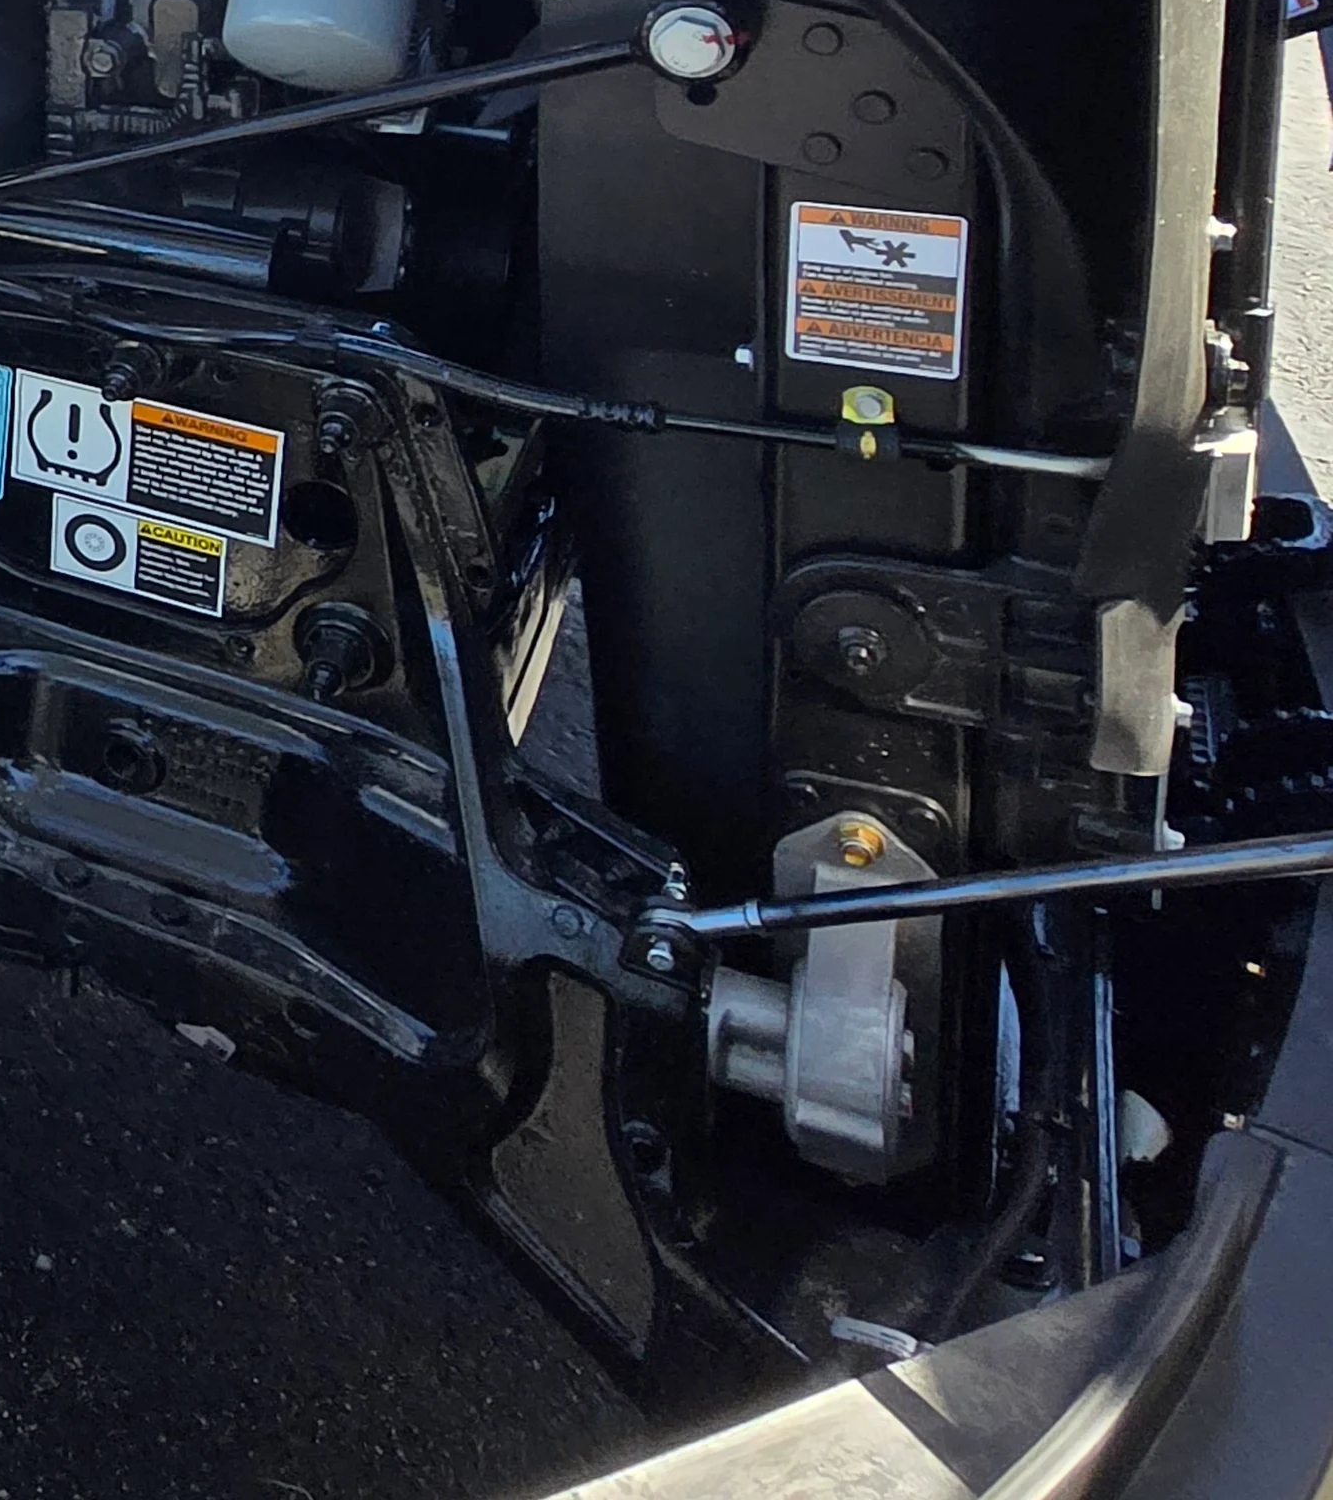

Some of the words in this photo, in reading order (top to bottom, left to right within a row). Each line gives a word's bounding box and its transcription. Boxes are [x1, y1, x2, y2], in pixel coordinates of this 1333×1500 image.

[849, 212, 930, 231] WARNING
[822, 283, 952, 308] AVERTISSEMENT
[829, 322, 943, 348] ADVERTENCIA
[174, 414, 248, 443] WARNING
[153, 526, 220, 553] CAUTION
